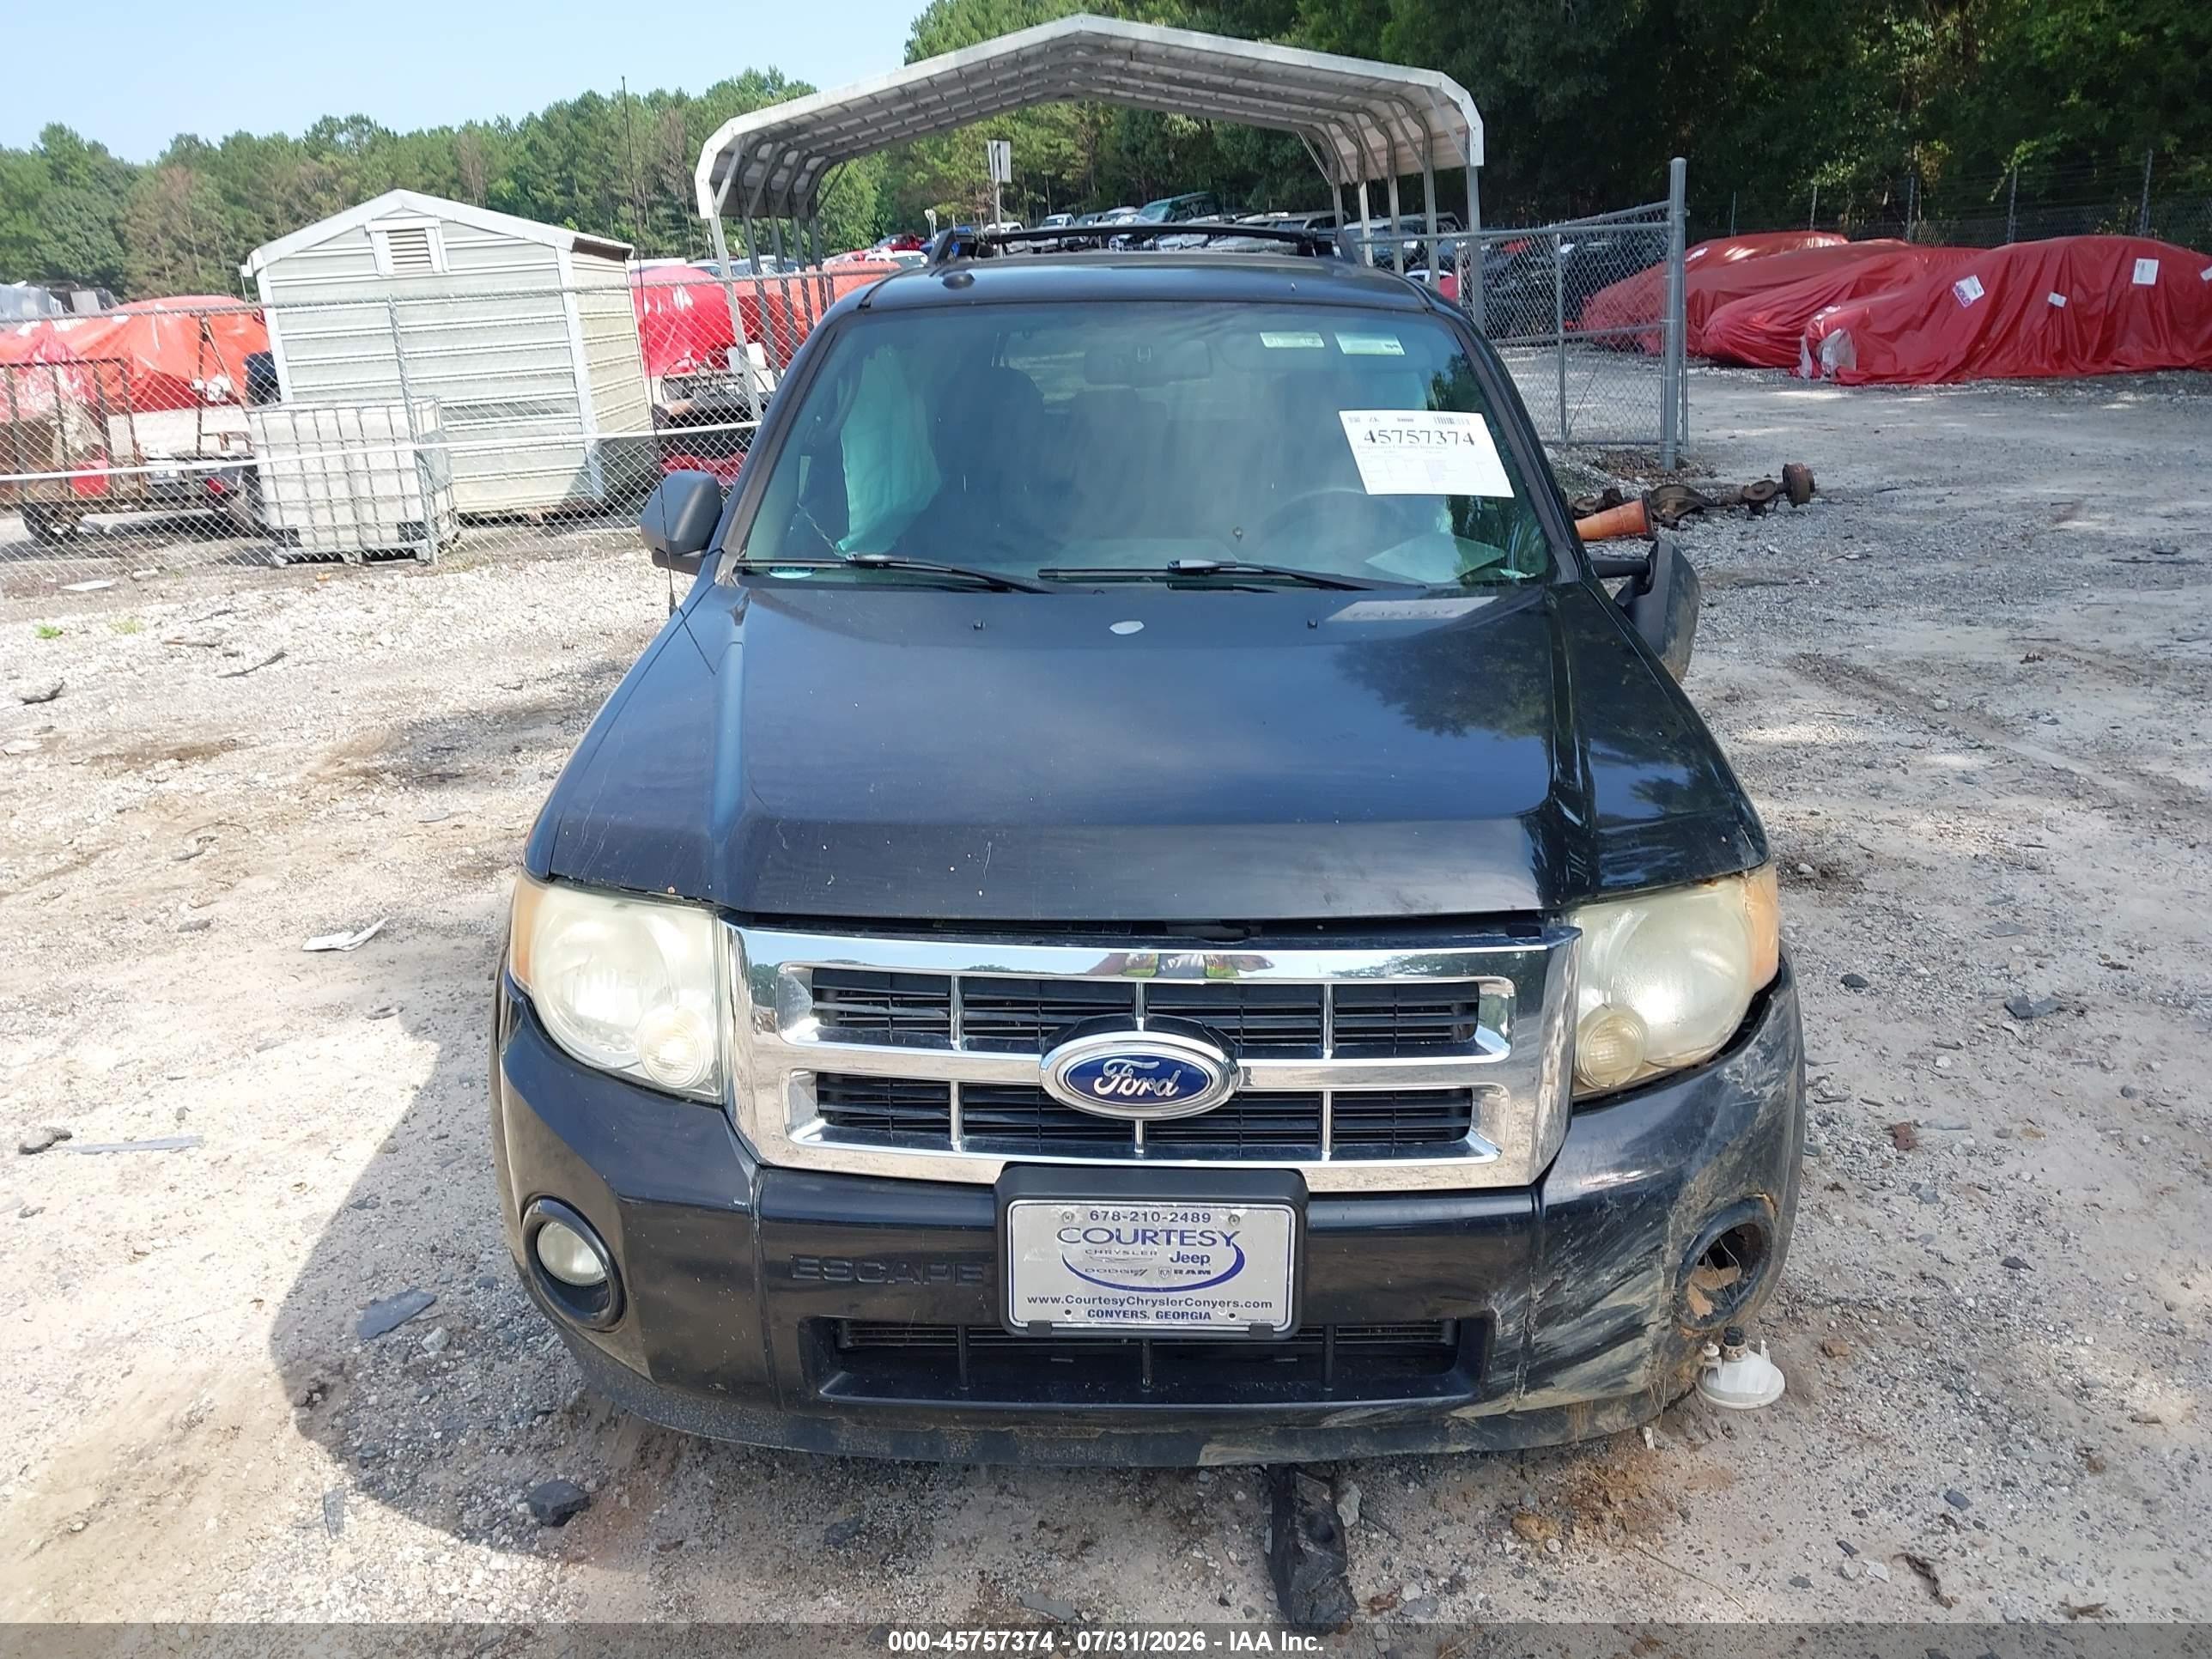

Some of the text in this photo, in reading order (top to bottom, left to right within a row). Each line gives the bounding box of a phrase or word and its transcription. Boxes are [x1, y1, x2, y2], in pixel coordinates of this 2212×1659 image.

[1364, 429, 1474, 446] 45757374
[1093, 1058, 1182, 1097] Ford
[1090, 1210, 1212, 1224] 678-210-2489
[1057, 1227, 1240, 1247] COURTESY
[1170, 1251, 1211, 1266] Jeep
[790, 1254, 985, 1285] ESCAPE
[1027, 1294, 1273, 1310] www.CourtesyChryslerConyers.com
[1156, 1310, 1212, 1321] GEORGIA
